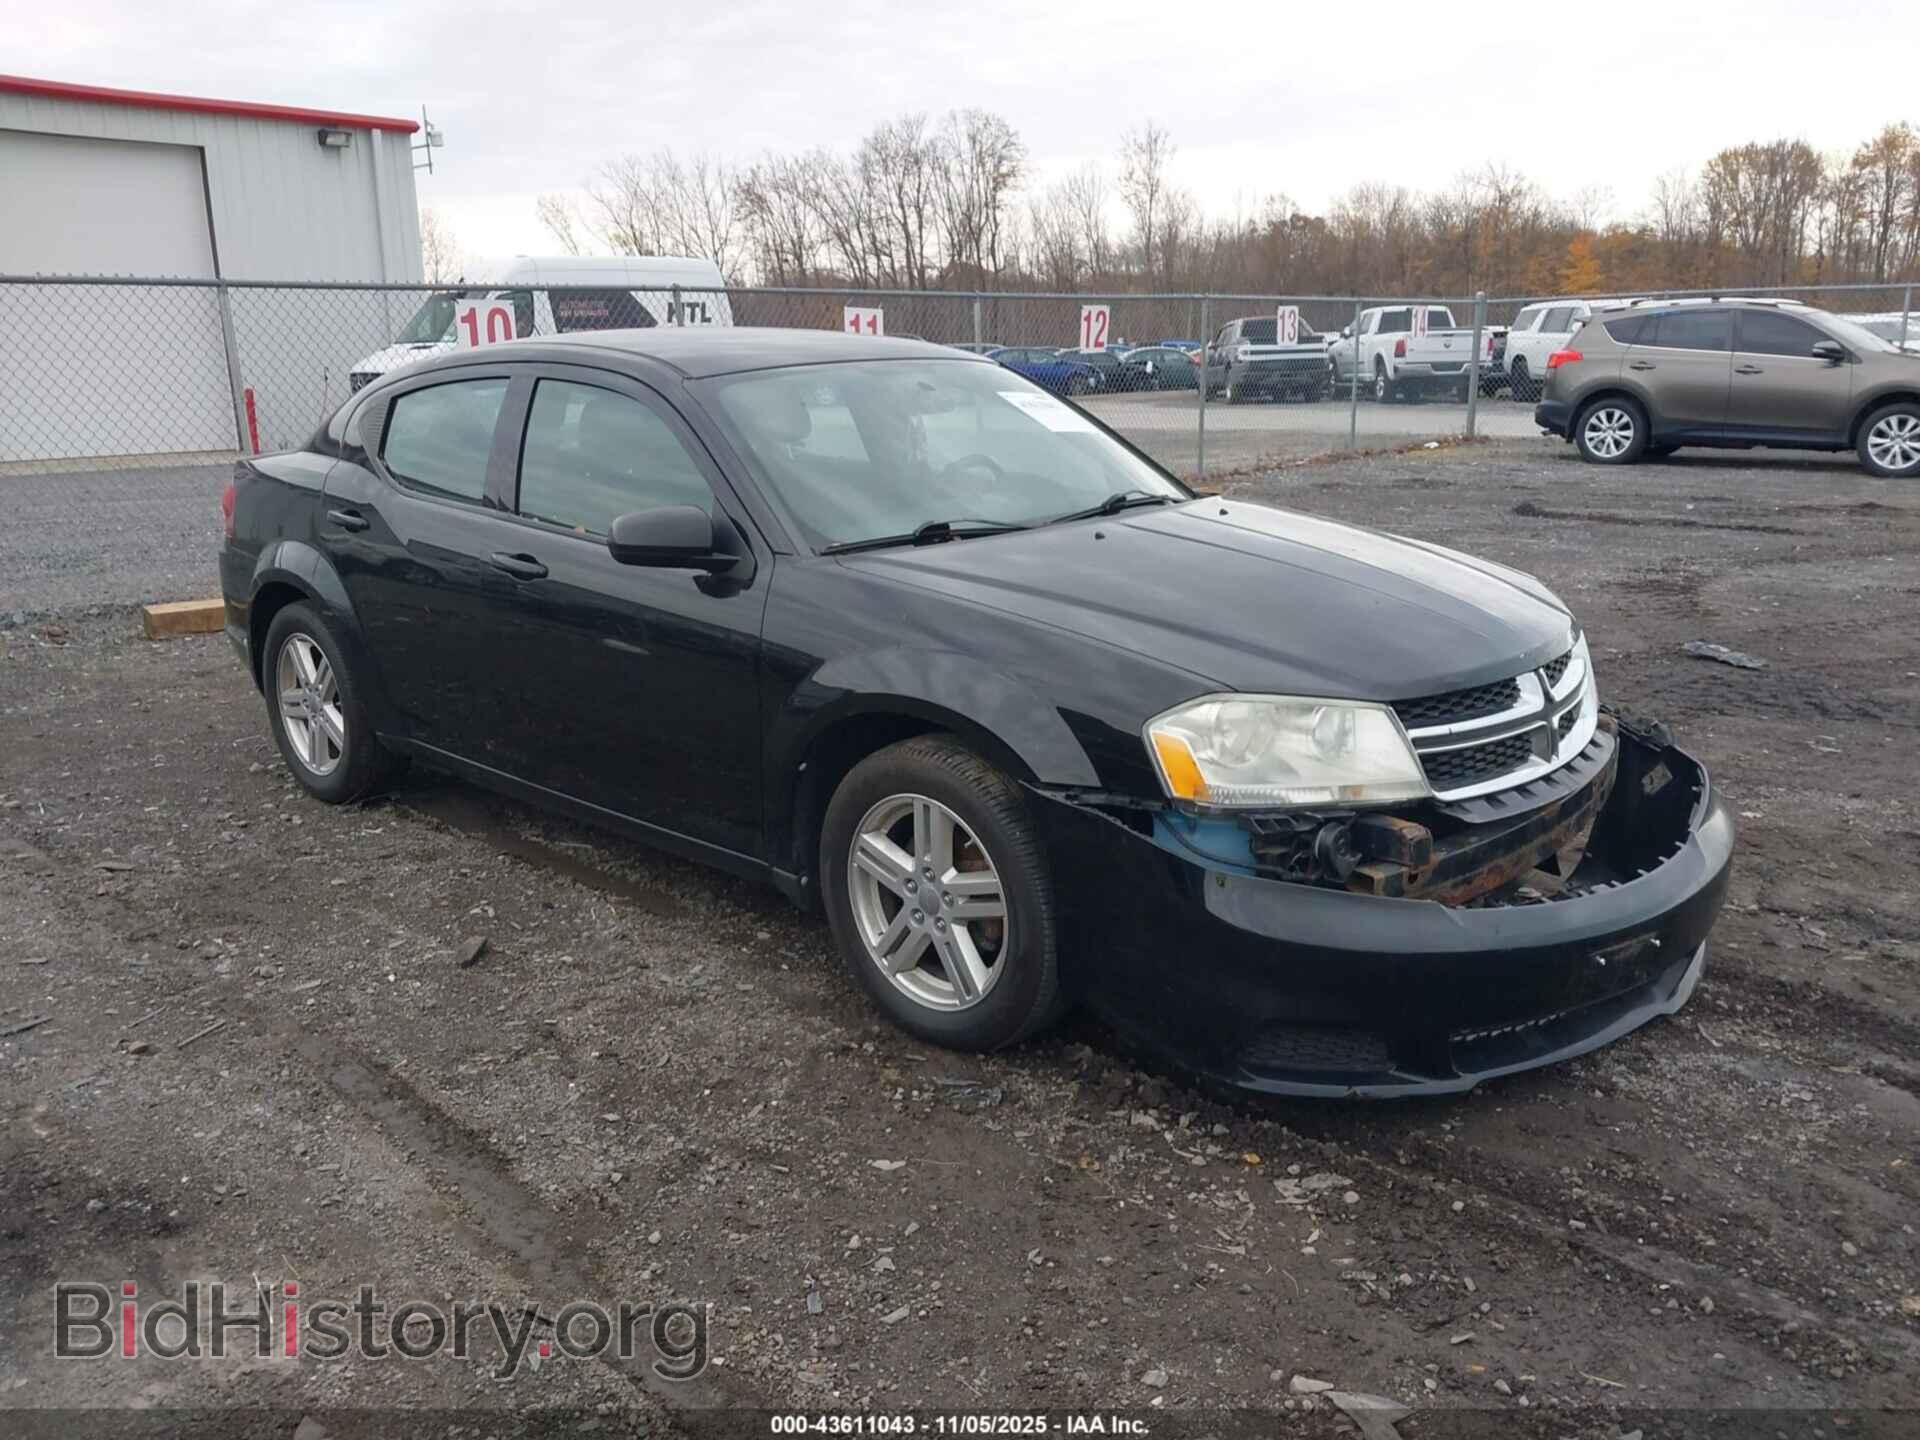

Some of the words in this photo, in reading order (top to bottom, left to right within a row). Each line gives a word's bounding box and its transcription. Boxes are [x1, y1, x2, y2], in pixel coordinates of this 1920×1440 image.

[461, 307, 512, 347] 10
[1083, 309, 1107, 348] 12
[1279, 310, 1297, 342] 13
